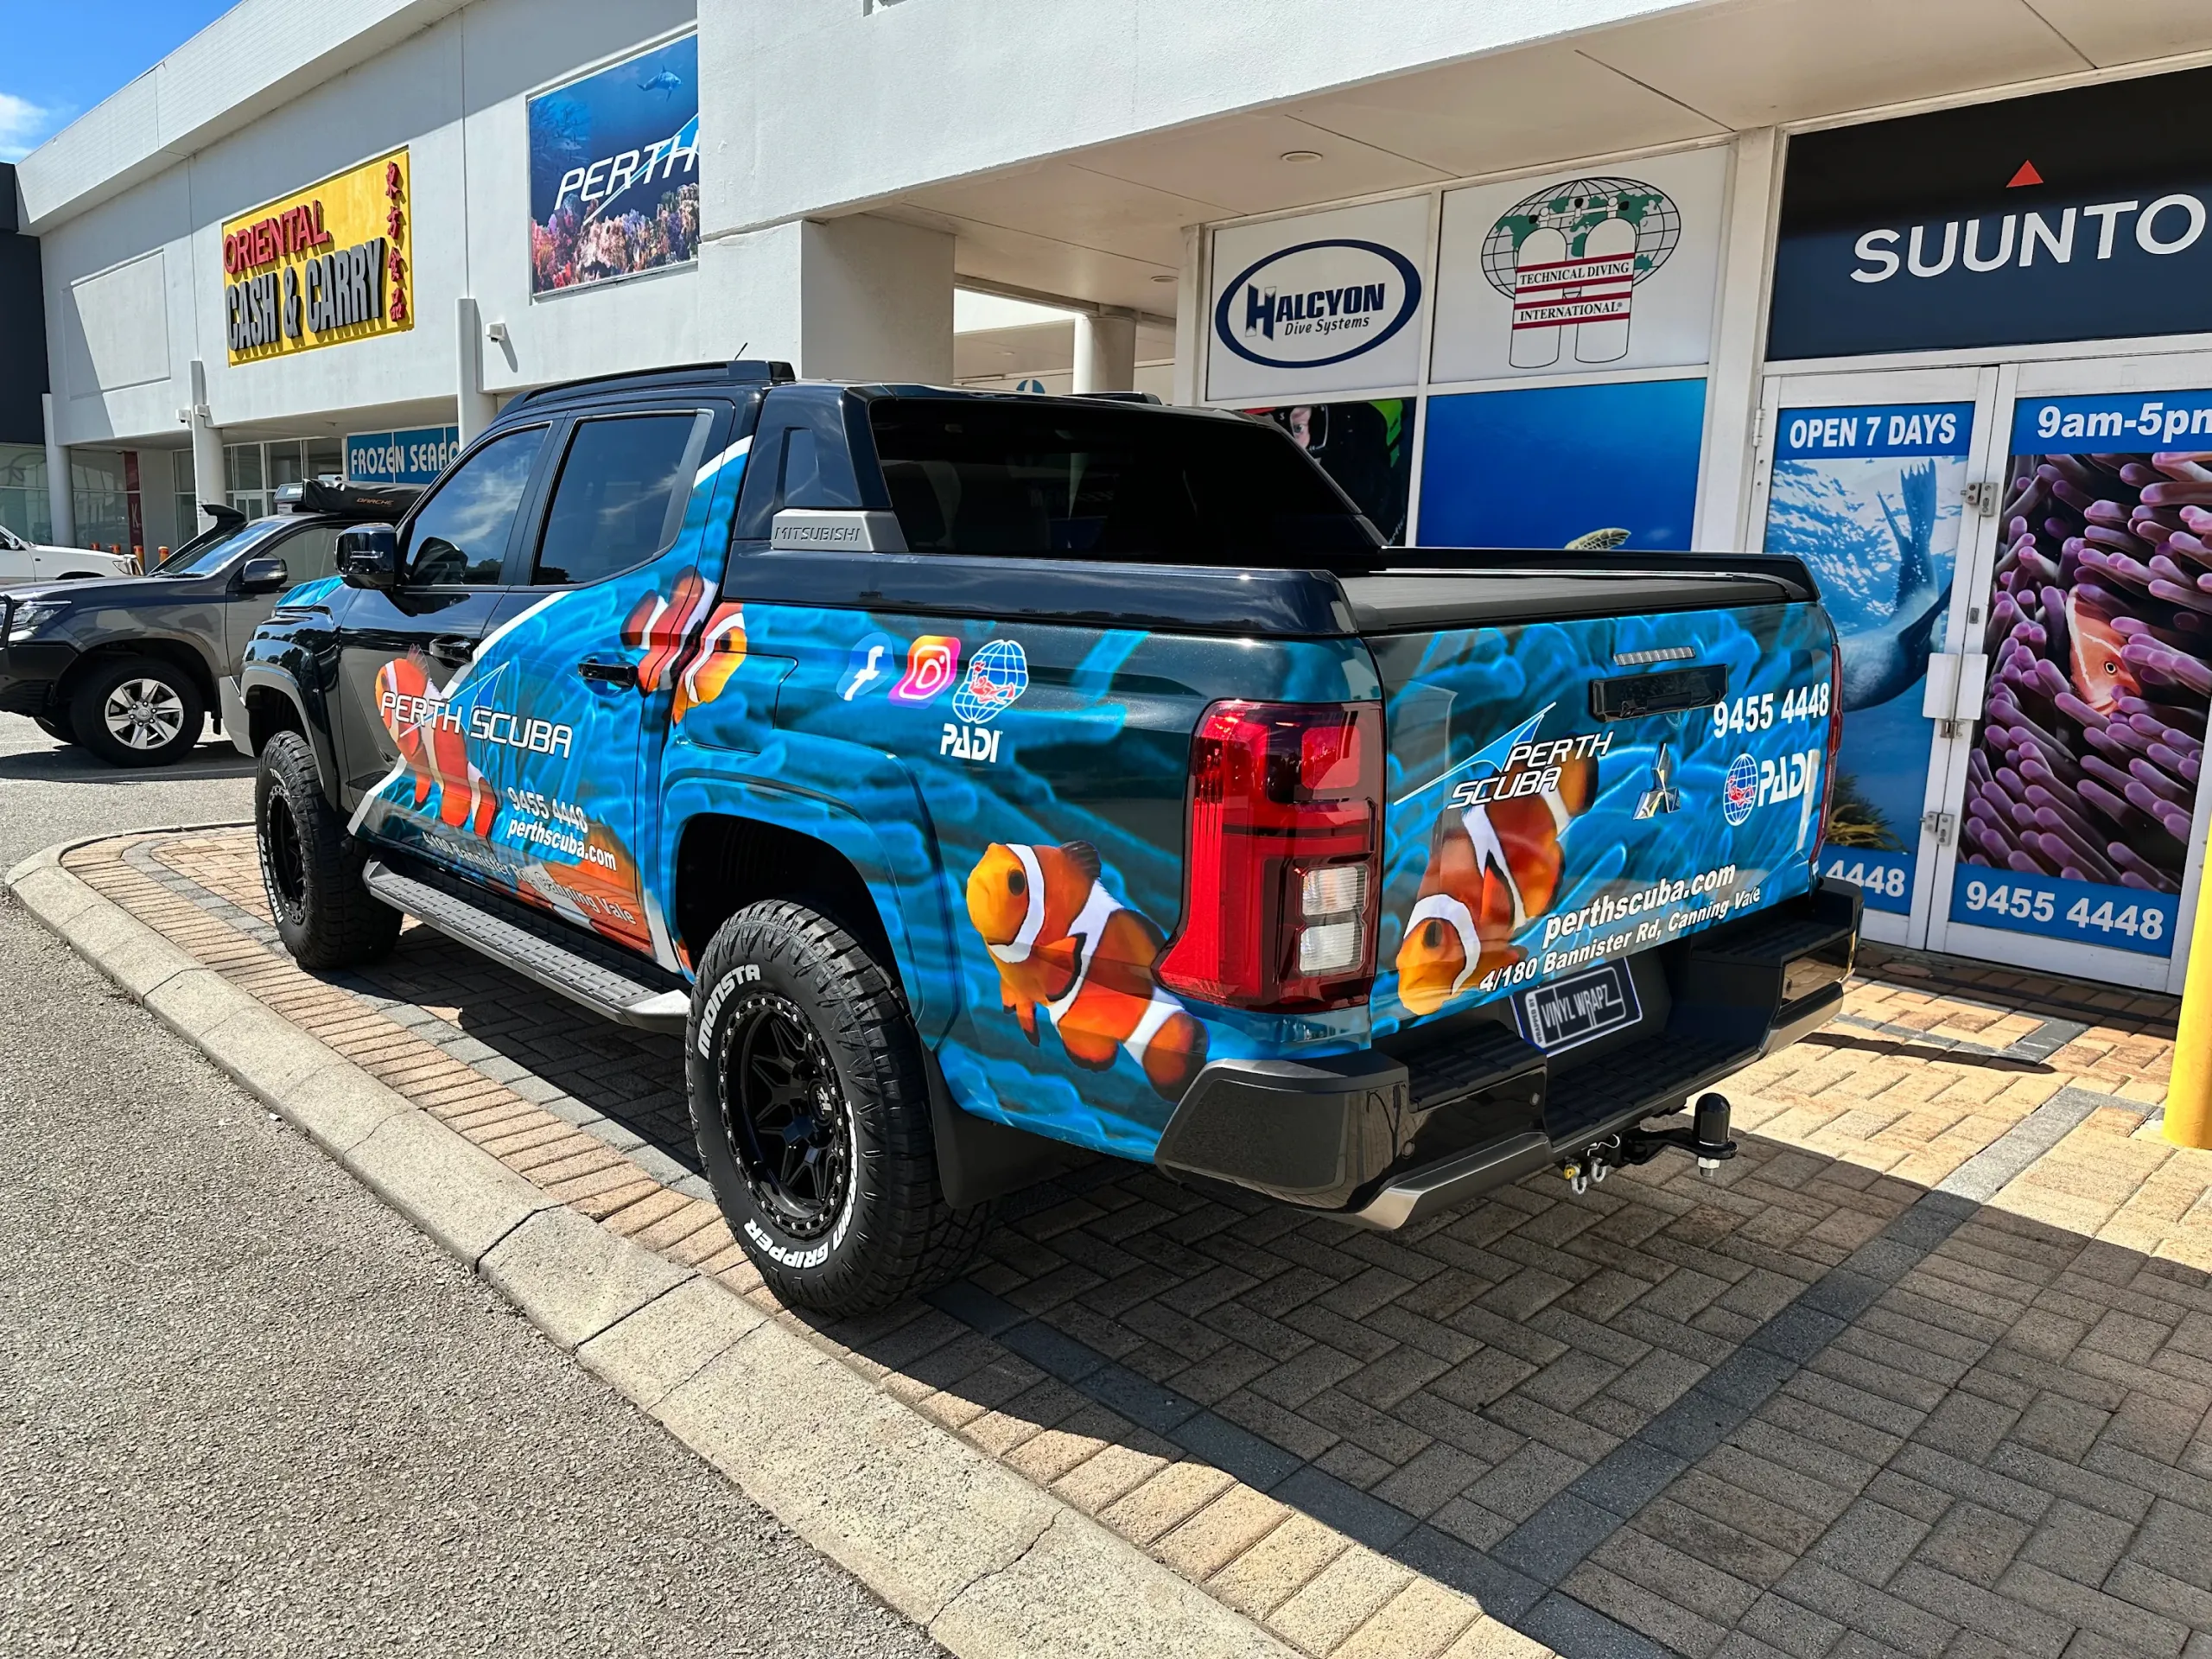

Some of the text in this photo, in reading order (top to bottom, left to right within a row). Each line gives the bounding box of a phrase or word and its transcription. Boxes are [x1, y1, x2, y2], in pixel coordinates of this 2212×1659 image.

[554, 130, 699, 211] PERTH
[224, 200, 329, 274] ORIENTAL
[1850, 194, 2206, 283] SUUNTO
[226, 238, 385, 351] CASH & CARRY
[1520, 262, 1630, 285] TECHNICAL DIVING
[1245, 283, 1386, 341] HALCYON
[1285, 317, 1370, 335] Dive Systems
[1789, 413, 1957, 448] OPEN 7 DAYS
[351, 445, 404, 475] FROZEN
[774, 526, 861, 542] MITSUBISHI
[380, 691, 573, 759] PERTH SCUBA
[1713, 682, 1829, 738] 9455 4448
[940, 722, 1001, 764] PADI
[1504, 732, 1613, 772] PERTH
[1447, 766, 1562, 809] SCUBA
[1758, 749, 1820, 807] PADI
[507, 786, 588, 834] 9455 4448
[506, 818, 617, 871] perthscuba.com
[450, 842, 512, 876] Bannister
[535, 872, 601, 914] Canning
[594, 894, 637, 925] Vale
[1541, 864, 1736, 950] perthscuba.com
[1966, 880, 2164, 940] 9455 4448
[1478, 885, 1761, 992] 4/180 Bannister Rd, Canning Vale
[1529, 998, 1543, 1044] WRAPPED BY
[1541, 984, 1611, 1028] VINYL WRAPZ
[743, 1218, 830, 1269] GRIPPER
